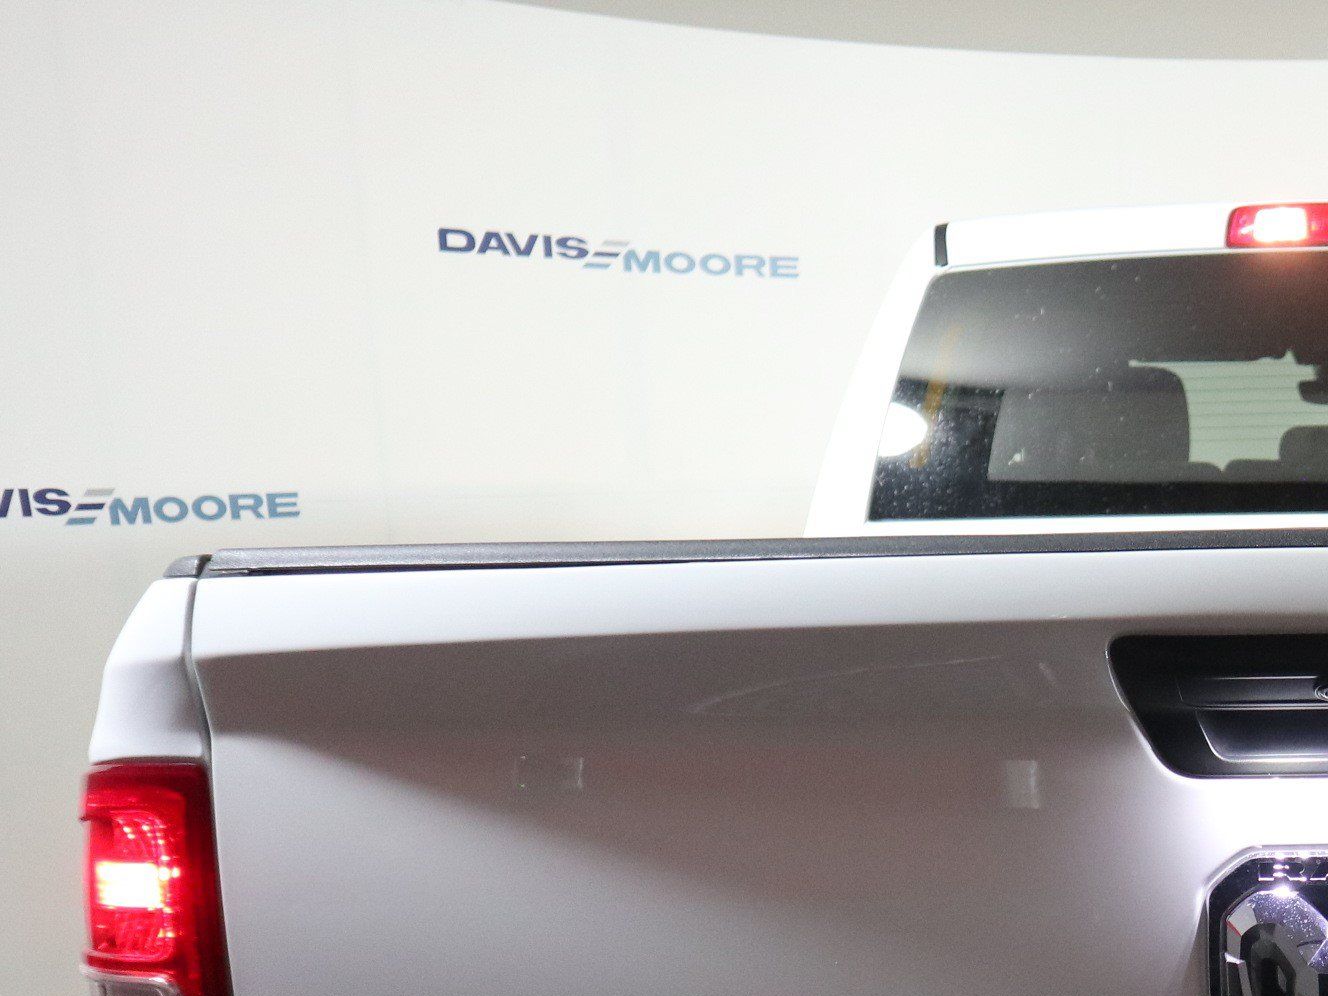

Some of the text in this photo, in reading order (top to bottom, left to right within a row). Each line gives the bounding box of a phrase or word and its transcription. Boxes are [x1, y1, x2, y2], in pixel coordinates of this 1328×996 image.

[437, 227, 800, 279] DAVIS MOORE
[108, 492, 300, 526] MOORE
